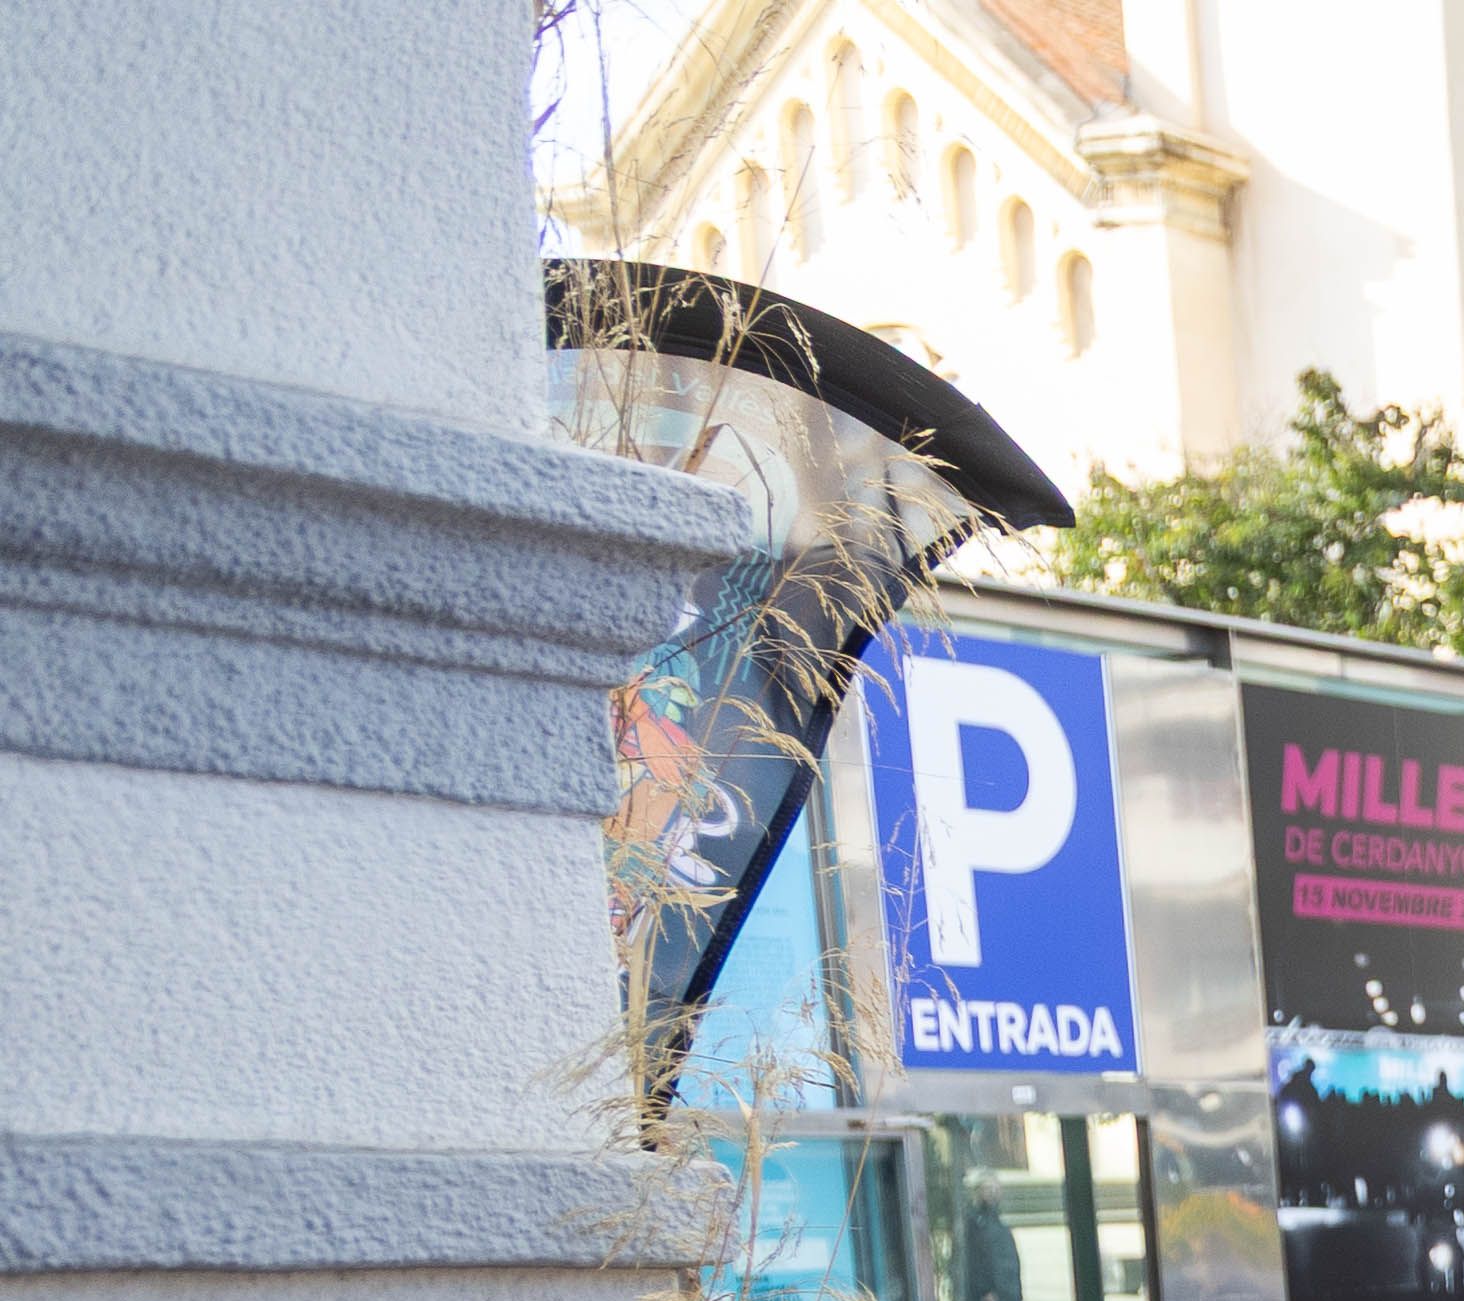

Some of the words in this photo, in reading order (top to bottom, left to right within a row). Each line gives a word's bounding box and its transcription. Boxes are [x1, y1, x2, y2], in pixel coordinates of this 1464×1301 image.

[903, 655, 1077, 967] P
[1284, 826, 1325, 865] DE
[1331, 887, 1453, 918] NOVEMBRE
[910, 1001, 1123, 1058] ENTRADA
